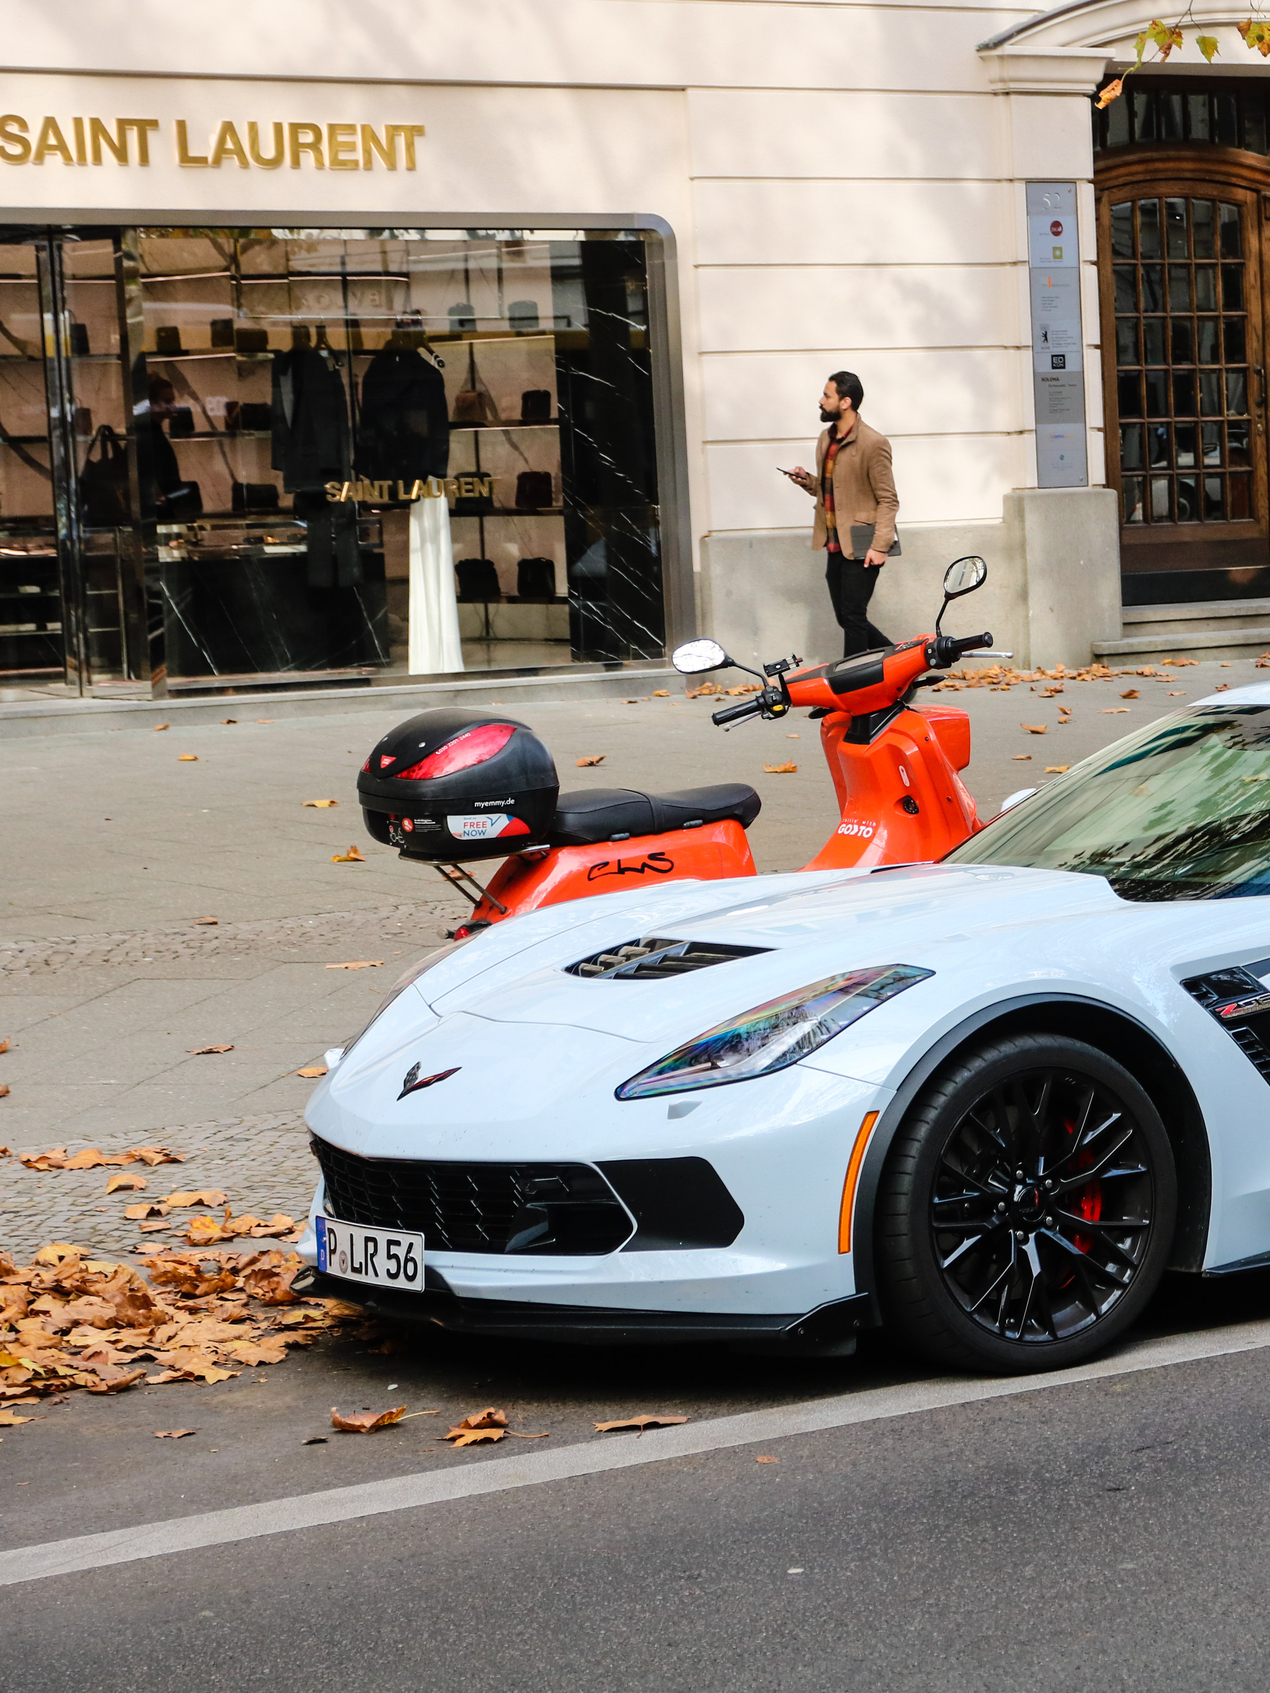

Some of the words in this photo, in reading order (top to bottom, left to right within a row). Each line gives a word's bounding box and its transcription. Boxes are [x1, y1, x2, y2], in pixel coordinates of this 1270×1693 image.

[0, 114, 160, 166] SAINT
[174, 119, 426, 171] LAURENT
[1043, 192, 1061, 210] 52
[324, 480, 394, 502] SAINT
[397, 477, 502, 500] LAURENT
[474, 798, 515, 808] myemmy.de
[463, 829, 487, 837] NOW
[464, 821, 487, 829] FREE
[327, 1227, 337, 1267] P
[350, 1233, 379, 1278] LR
[386, 1239, 418, 1282] 56
